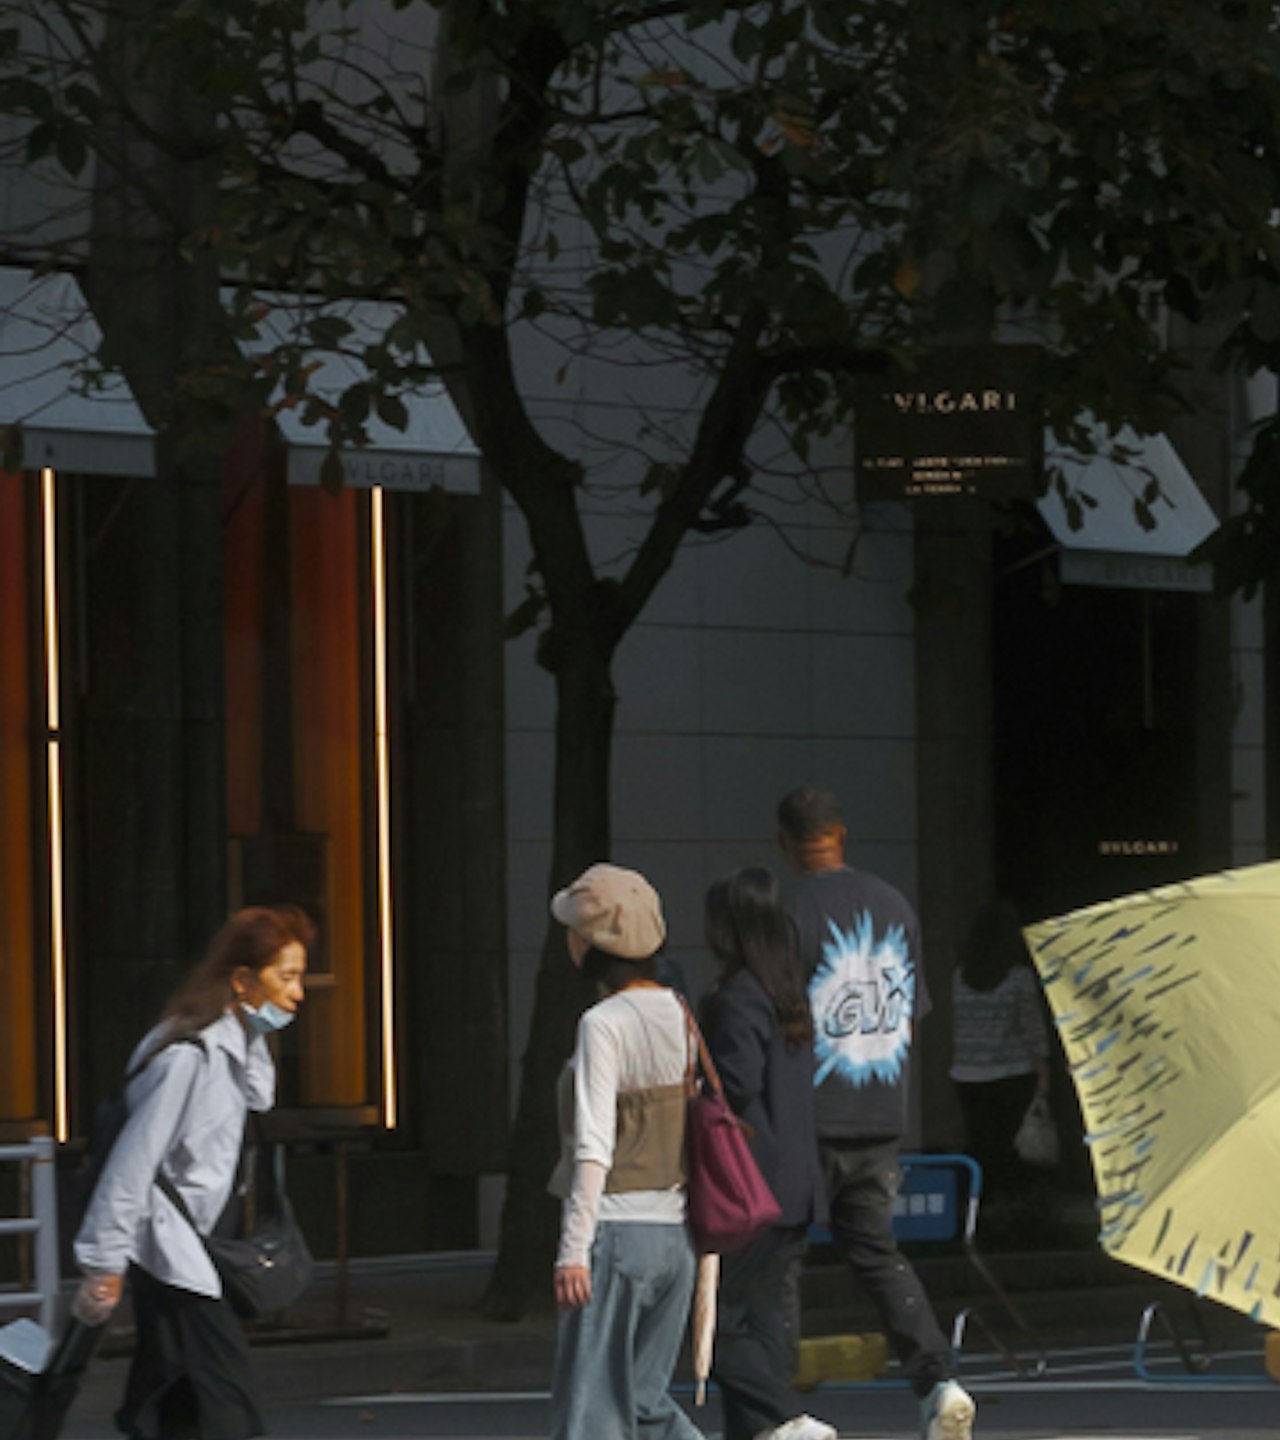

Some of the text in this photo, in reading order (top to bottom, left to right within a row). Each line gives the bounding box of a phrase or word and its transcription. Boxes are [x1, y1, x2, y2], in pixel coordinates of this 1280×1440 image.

[881, 388, 1017, 415] VLGARI
[346, 458, 446, 486] VLGARI
[1099, 840, 1179, 856] BVLGARI
